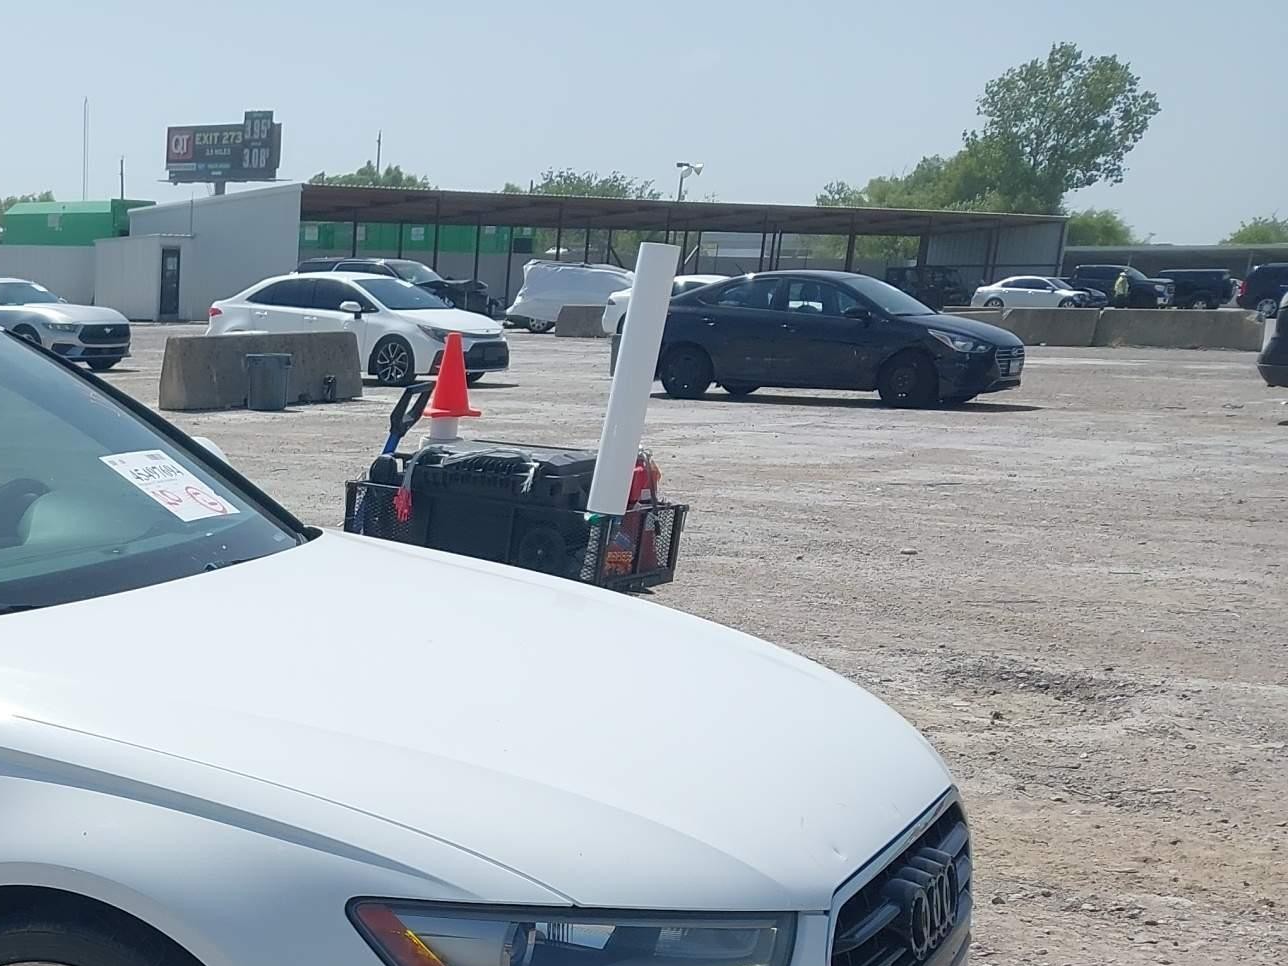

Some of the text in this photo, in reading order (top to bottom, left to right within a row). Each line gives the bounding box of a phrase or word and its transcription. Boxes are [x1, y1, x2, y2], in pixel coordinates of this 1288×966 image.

[172, 135, 190, 155] QT
[195, 131, 243, 145] EXIT 273
